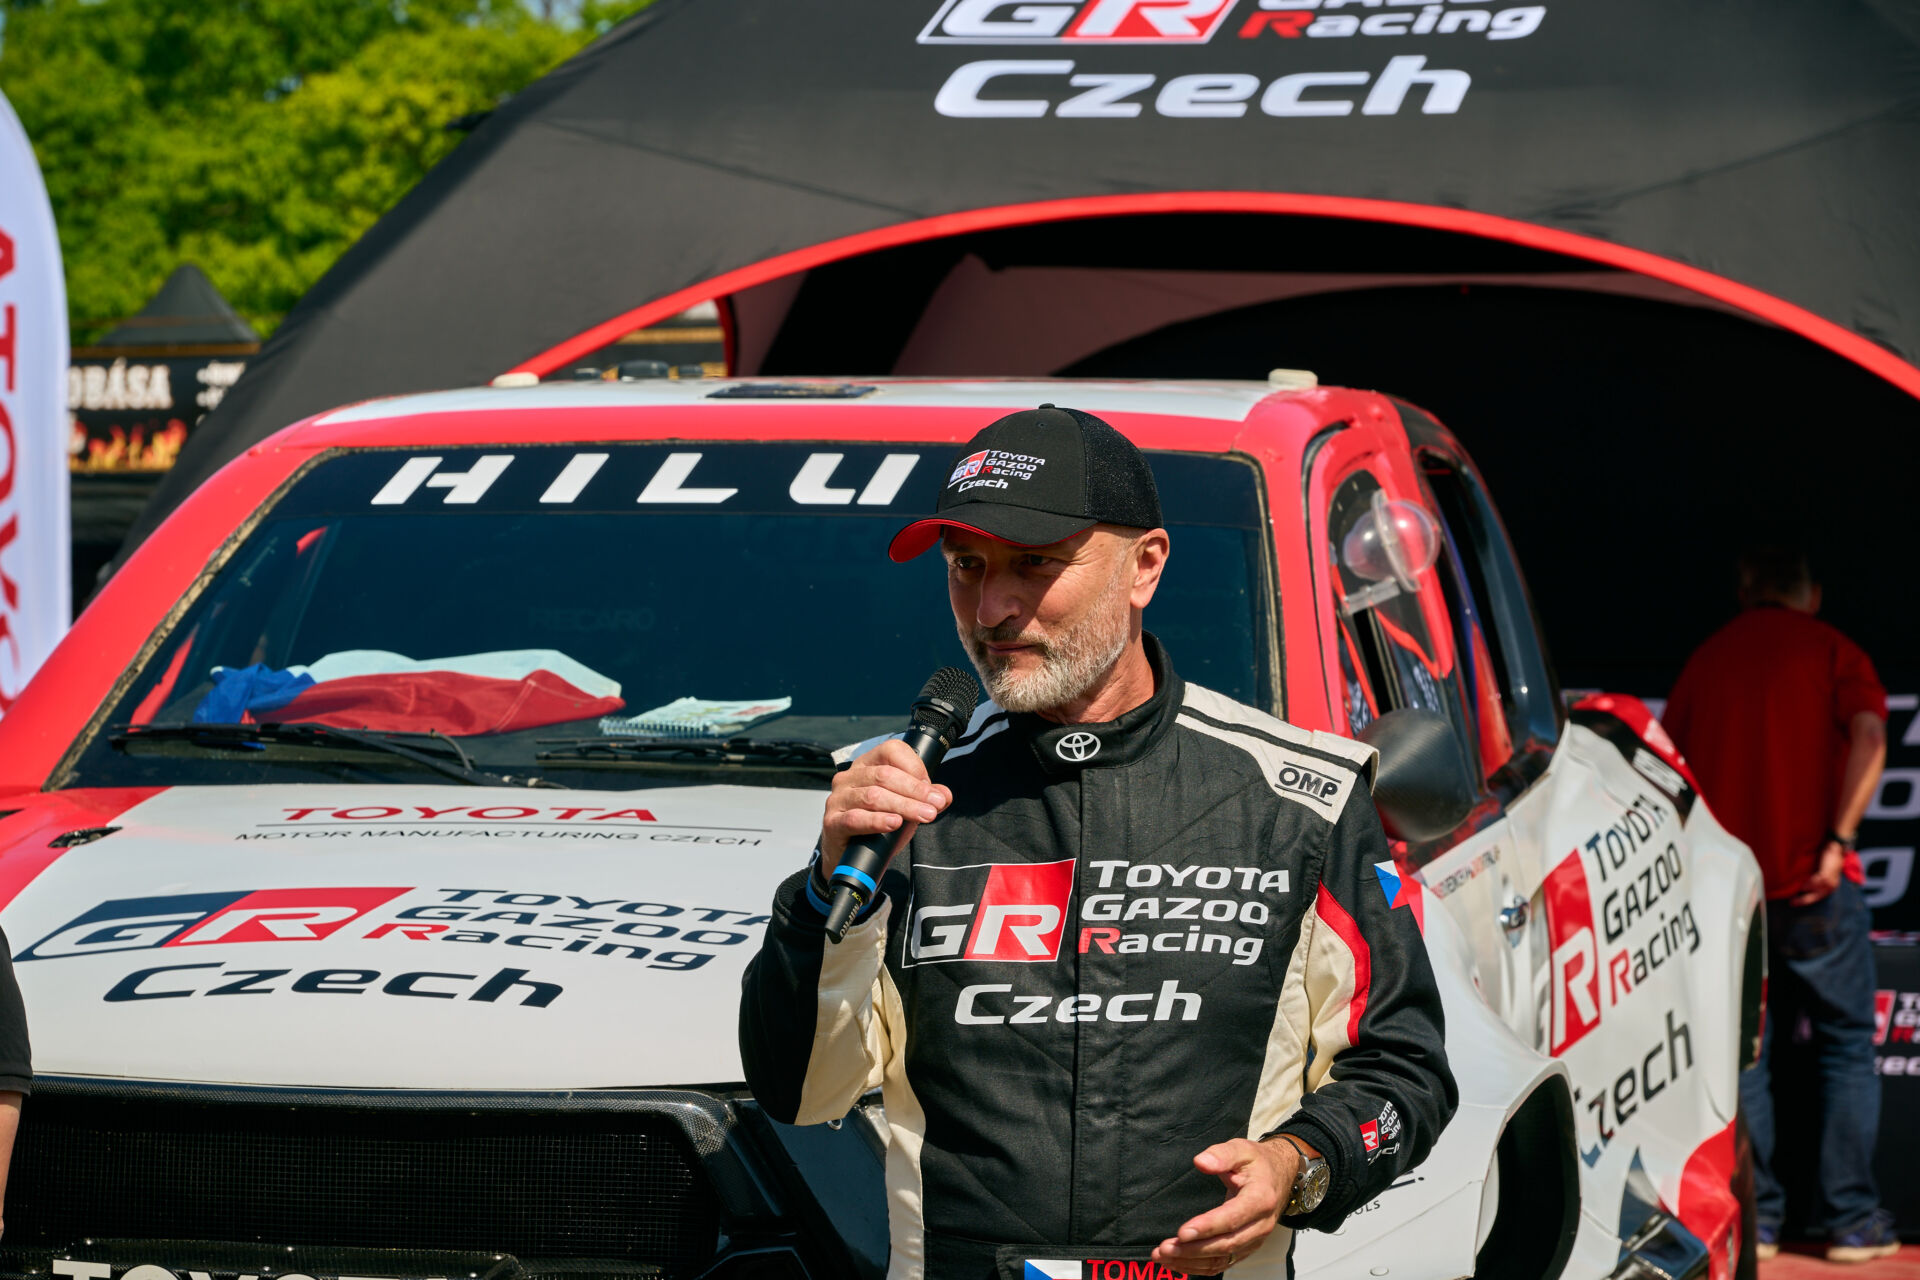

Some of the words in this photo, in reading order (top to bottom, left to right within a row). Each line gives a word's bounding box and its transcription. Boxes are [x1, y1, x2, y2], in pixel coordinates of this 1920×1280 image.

[1237, 5, 1547, 40] Racing
[934, 55, 1472, 118] Czech
[950, 460, 981, 482] GR
[981, 465, 1033, 480] Racing
[985, 458, 1037, 472] GAZOO
[990, 450, 1046, 465] TOYOTA
[958, 479, 1009, 493] Czech
[1279, 767, 1338, 798] OMP
[282, 806, 658, 822] TOYOTA
[235, 831, 351, 840] MOTOR
[360, 830, 639, 840] MANUFACTURING
[650, 834, 762, 846] CZECH
[1586, 792, 1670, 882] TOYOTA
[1089, 860, 1290, 893] TOYOTA
[1604, 842, 1683, 944] GAZOO
[395, 906, 749, 945] GAZOO
[1081, 893, 1269, 926] GAZOO
[32, 907, 359, 957] GR
[361, 923, 716, 971] Racing
[911, 904, 1061, 959] GR
[1078, 925, 1264, 965] Racing
[1608, 902, 1701, 1007] Racing
[103, 961, 564, 1009] Czech
[954, 980, 1202, 1025] Czech
